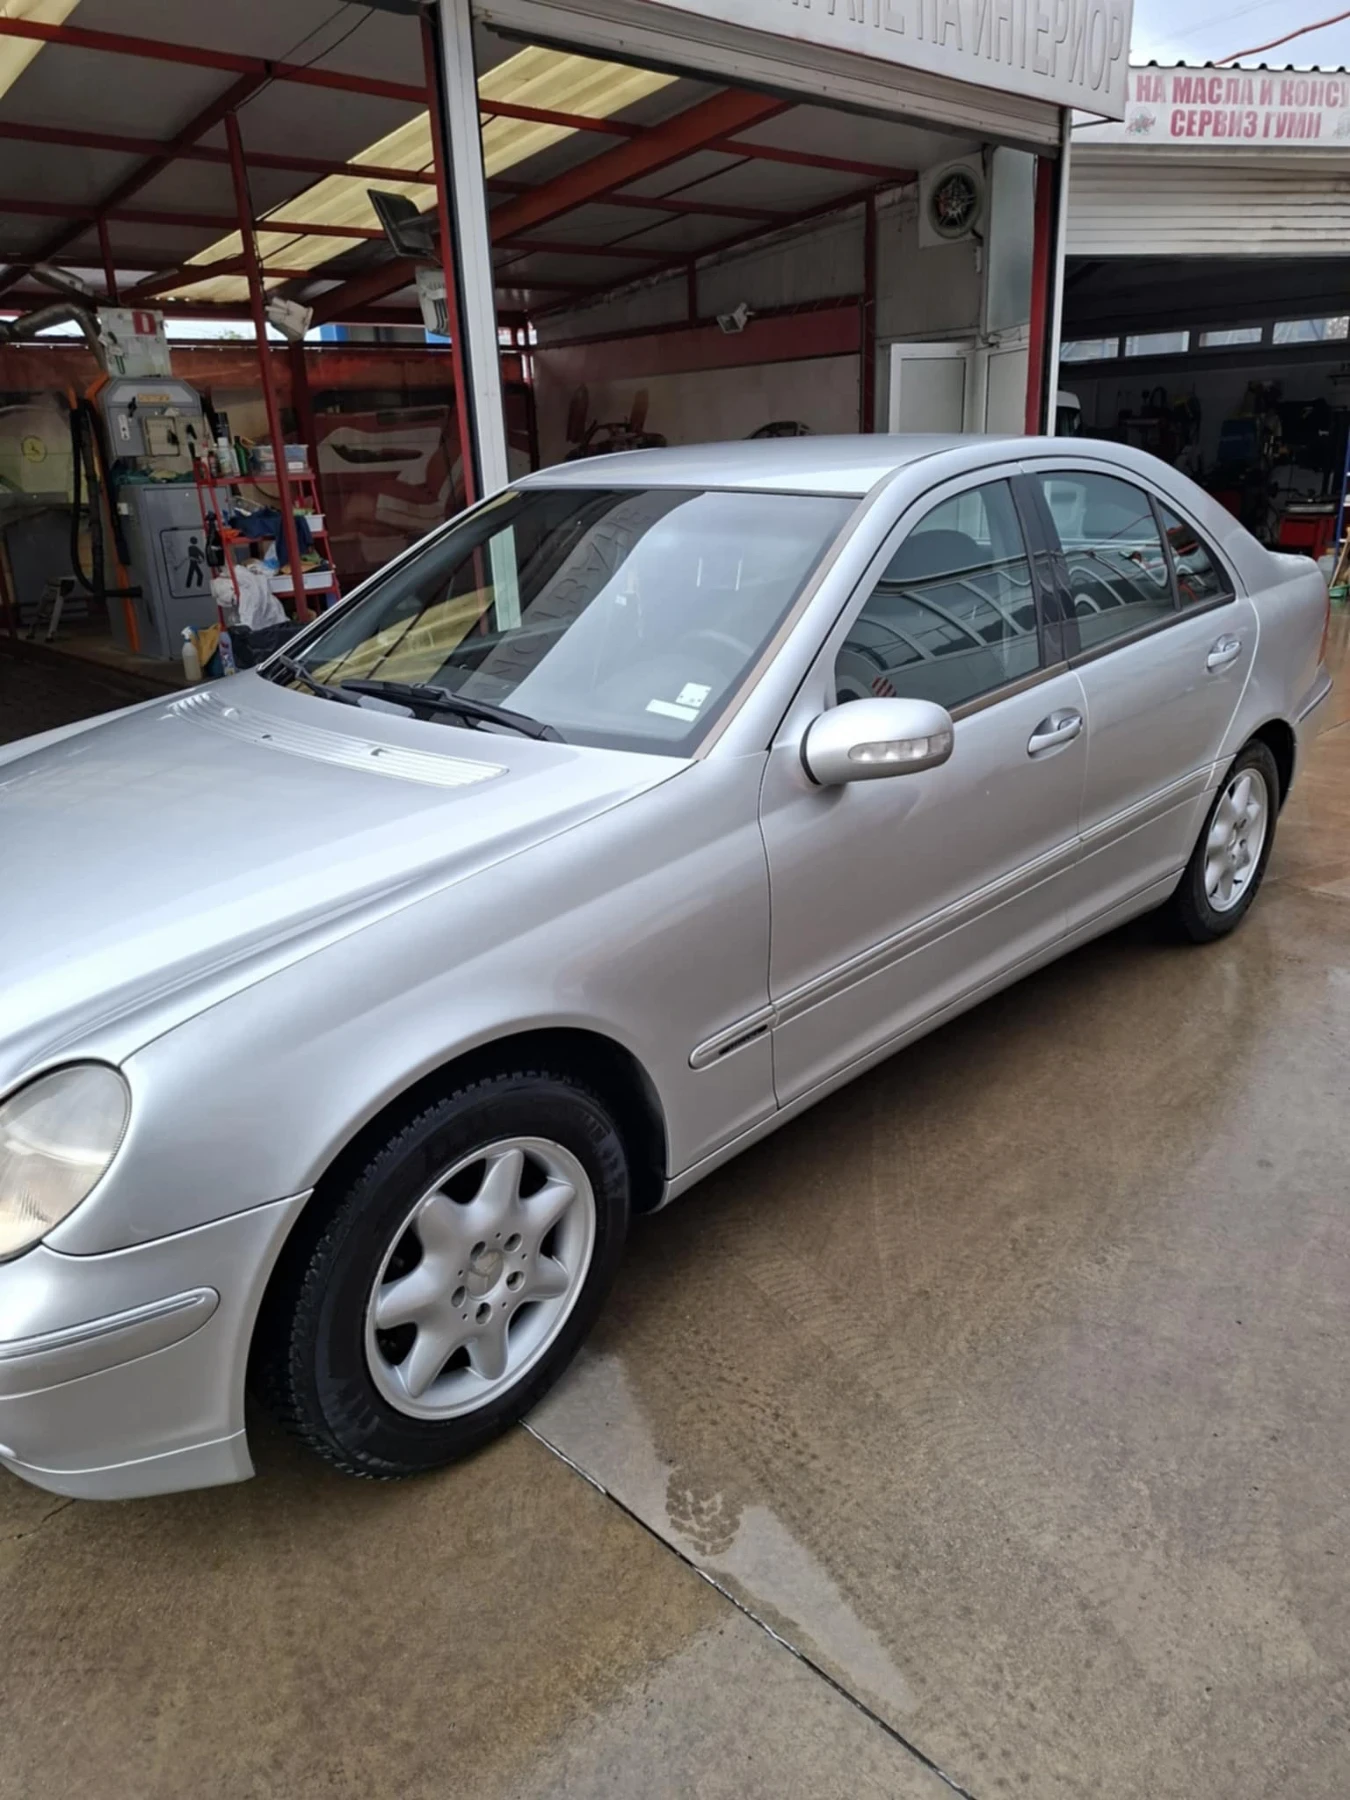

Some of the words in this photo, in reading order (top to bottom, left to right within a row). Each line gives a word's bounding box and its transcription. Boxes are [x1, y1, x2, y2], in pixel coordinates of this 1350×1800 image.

[1136, 75, 1165, 103] НА
[1172, 76, 1254, 105] МАСЛА
[1259, 78, 1275, 105] И
[1170, 109, 1258, 138] СЕРВИЗ
[1262, 111, 1322, 139] ГУМИ
